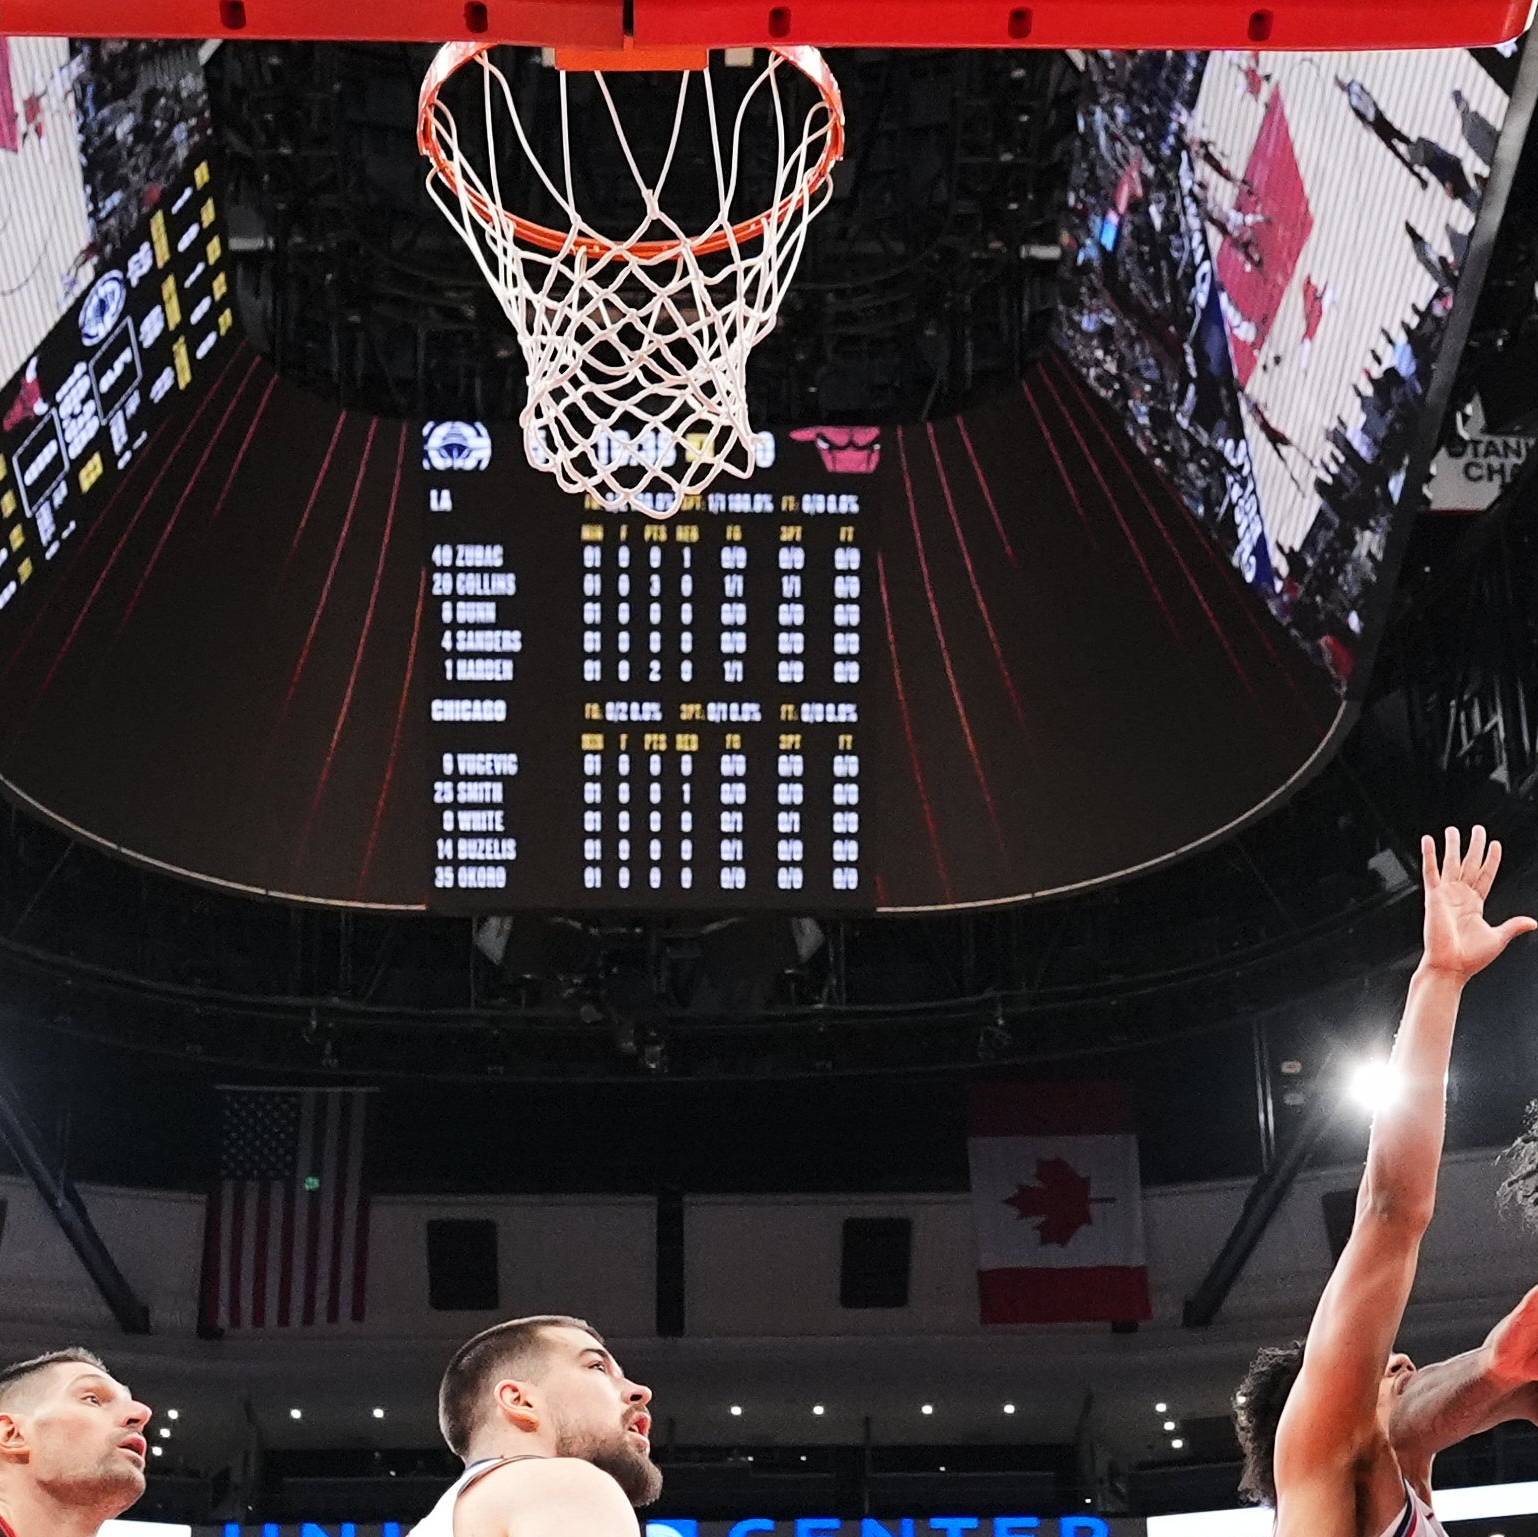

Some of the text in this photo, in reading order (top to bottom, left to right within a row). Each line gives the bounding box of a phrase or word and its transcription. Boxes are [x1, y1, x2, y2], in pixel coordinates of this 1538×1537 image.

[431, 699, 506, 721] CHICAGO
[457, 781, 503, 803] SMITH
[457, 810, 504, 831] WHITE
